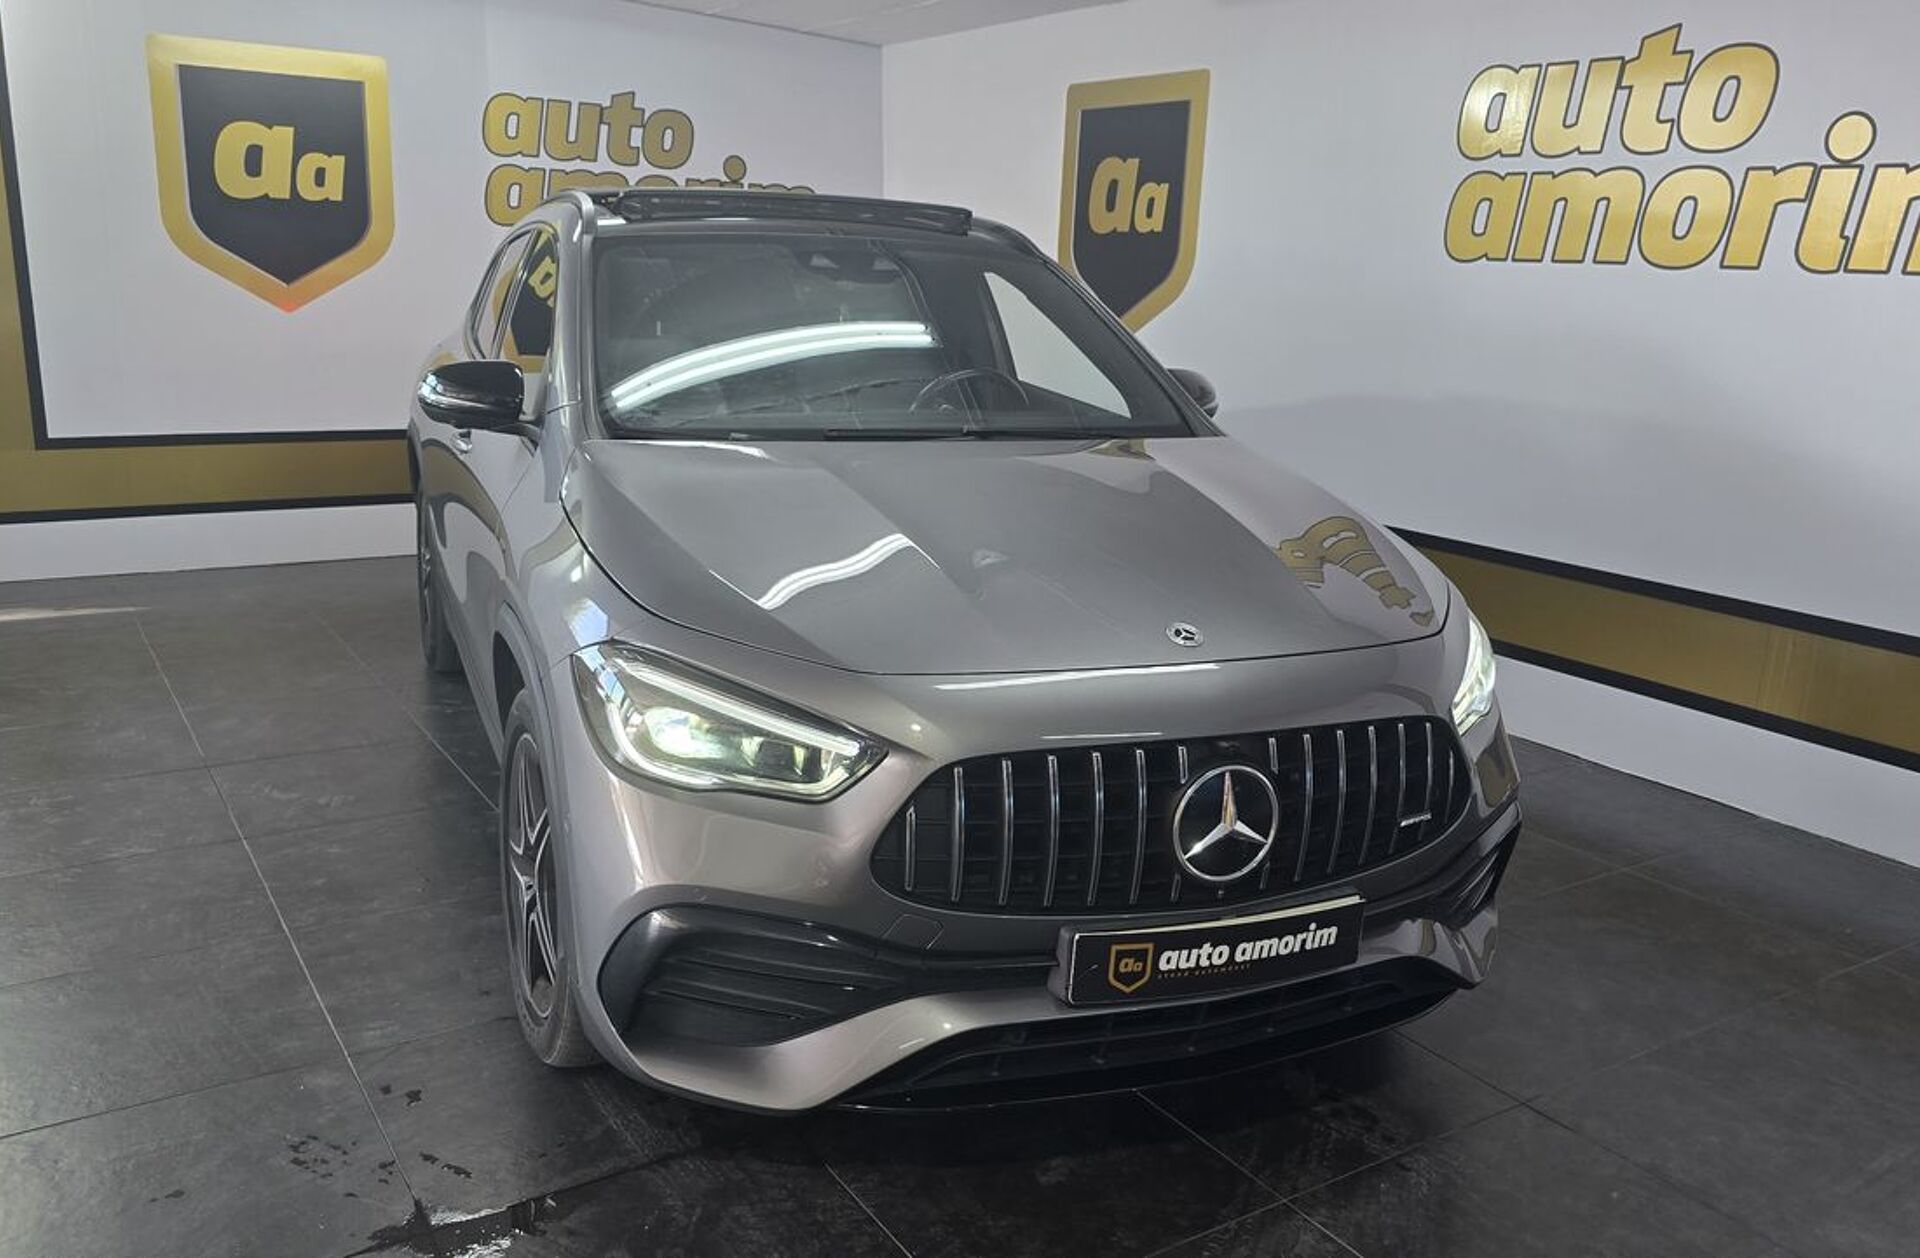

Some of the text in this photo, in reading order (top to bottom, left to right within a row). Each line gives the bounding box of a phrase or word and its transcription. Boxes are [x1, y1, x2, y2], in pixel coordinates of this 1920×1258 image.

[482, 91, 694, 170] auto
[1457, 23, 1780, 161] auto
[214, 121, 346, 202] aa
[1089, 156, 1169, 234] aa
[1158, 941, 1230, 971] auto
[1234, 921, 1338, 962] amorim
